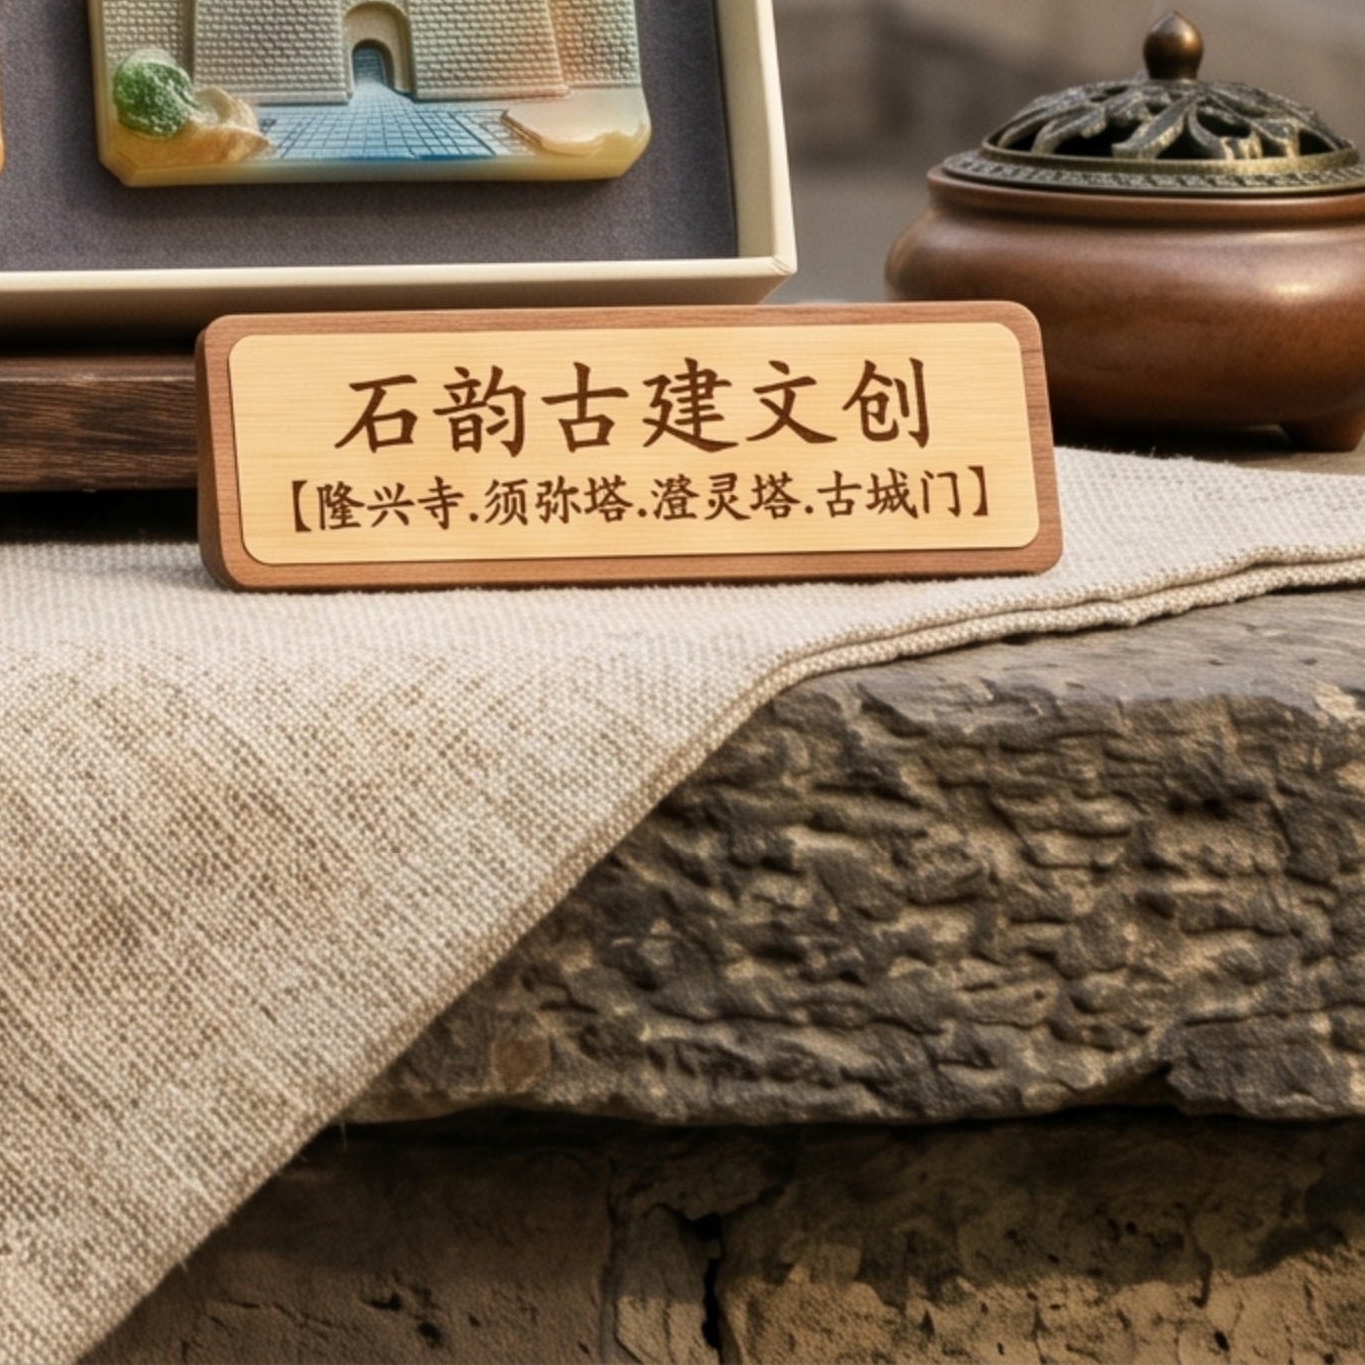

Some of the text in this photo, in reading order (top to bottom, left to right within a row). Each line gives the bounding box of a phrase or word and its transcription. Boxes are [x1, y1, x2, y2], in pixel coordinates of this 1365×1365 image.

[333, 356, 930, 458] 石韵古建文创
